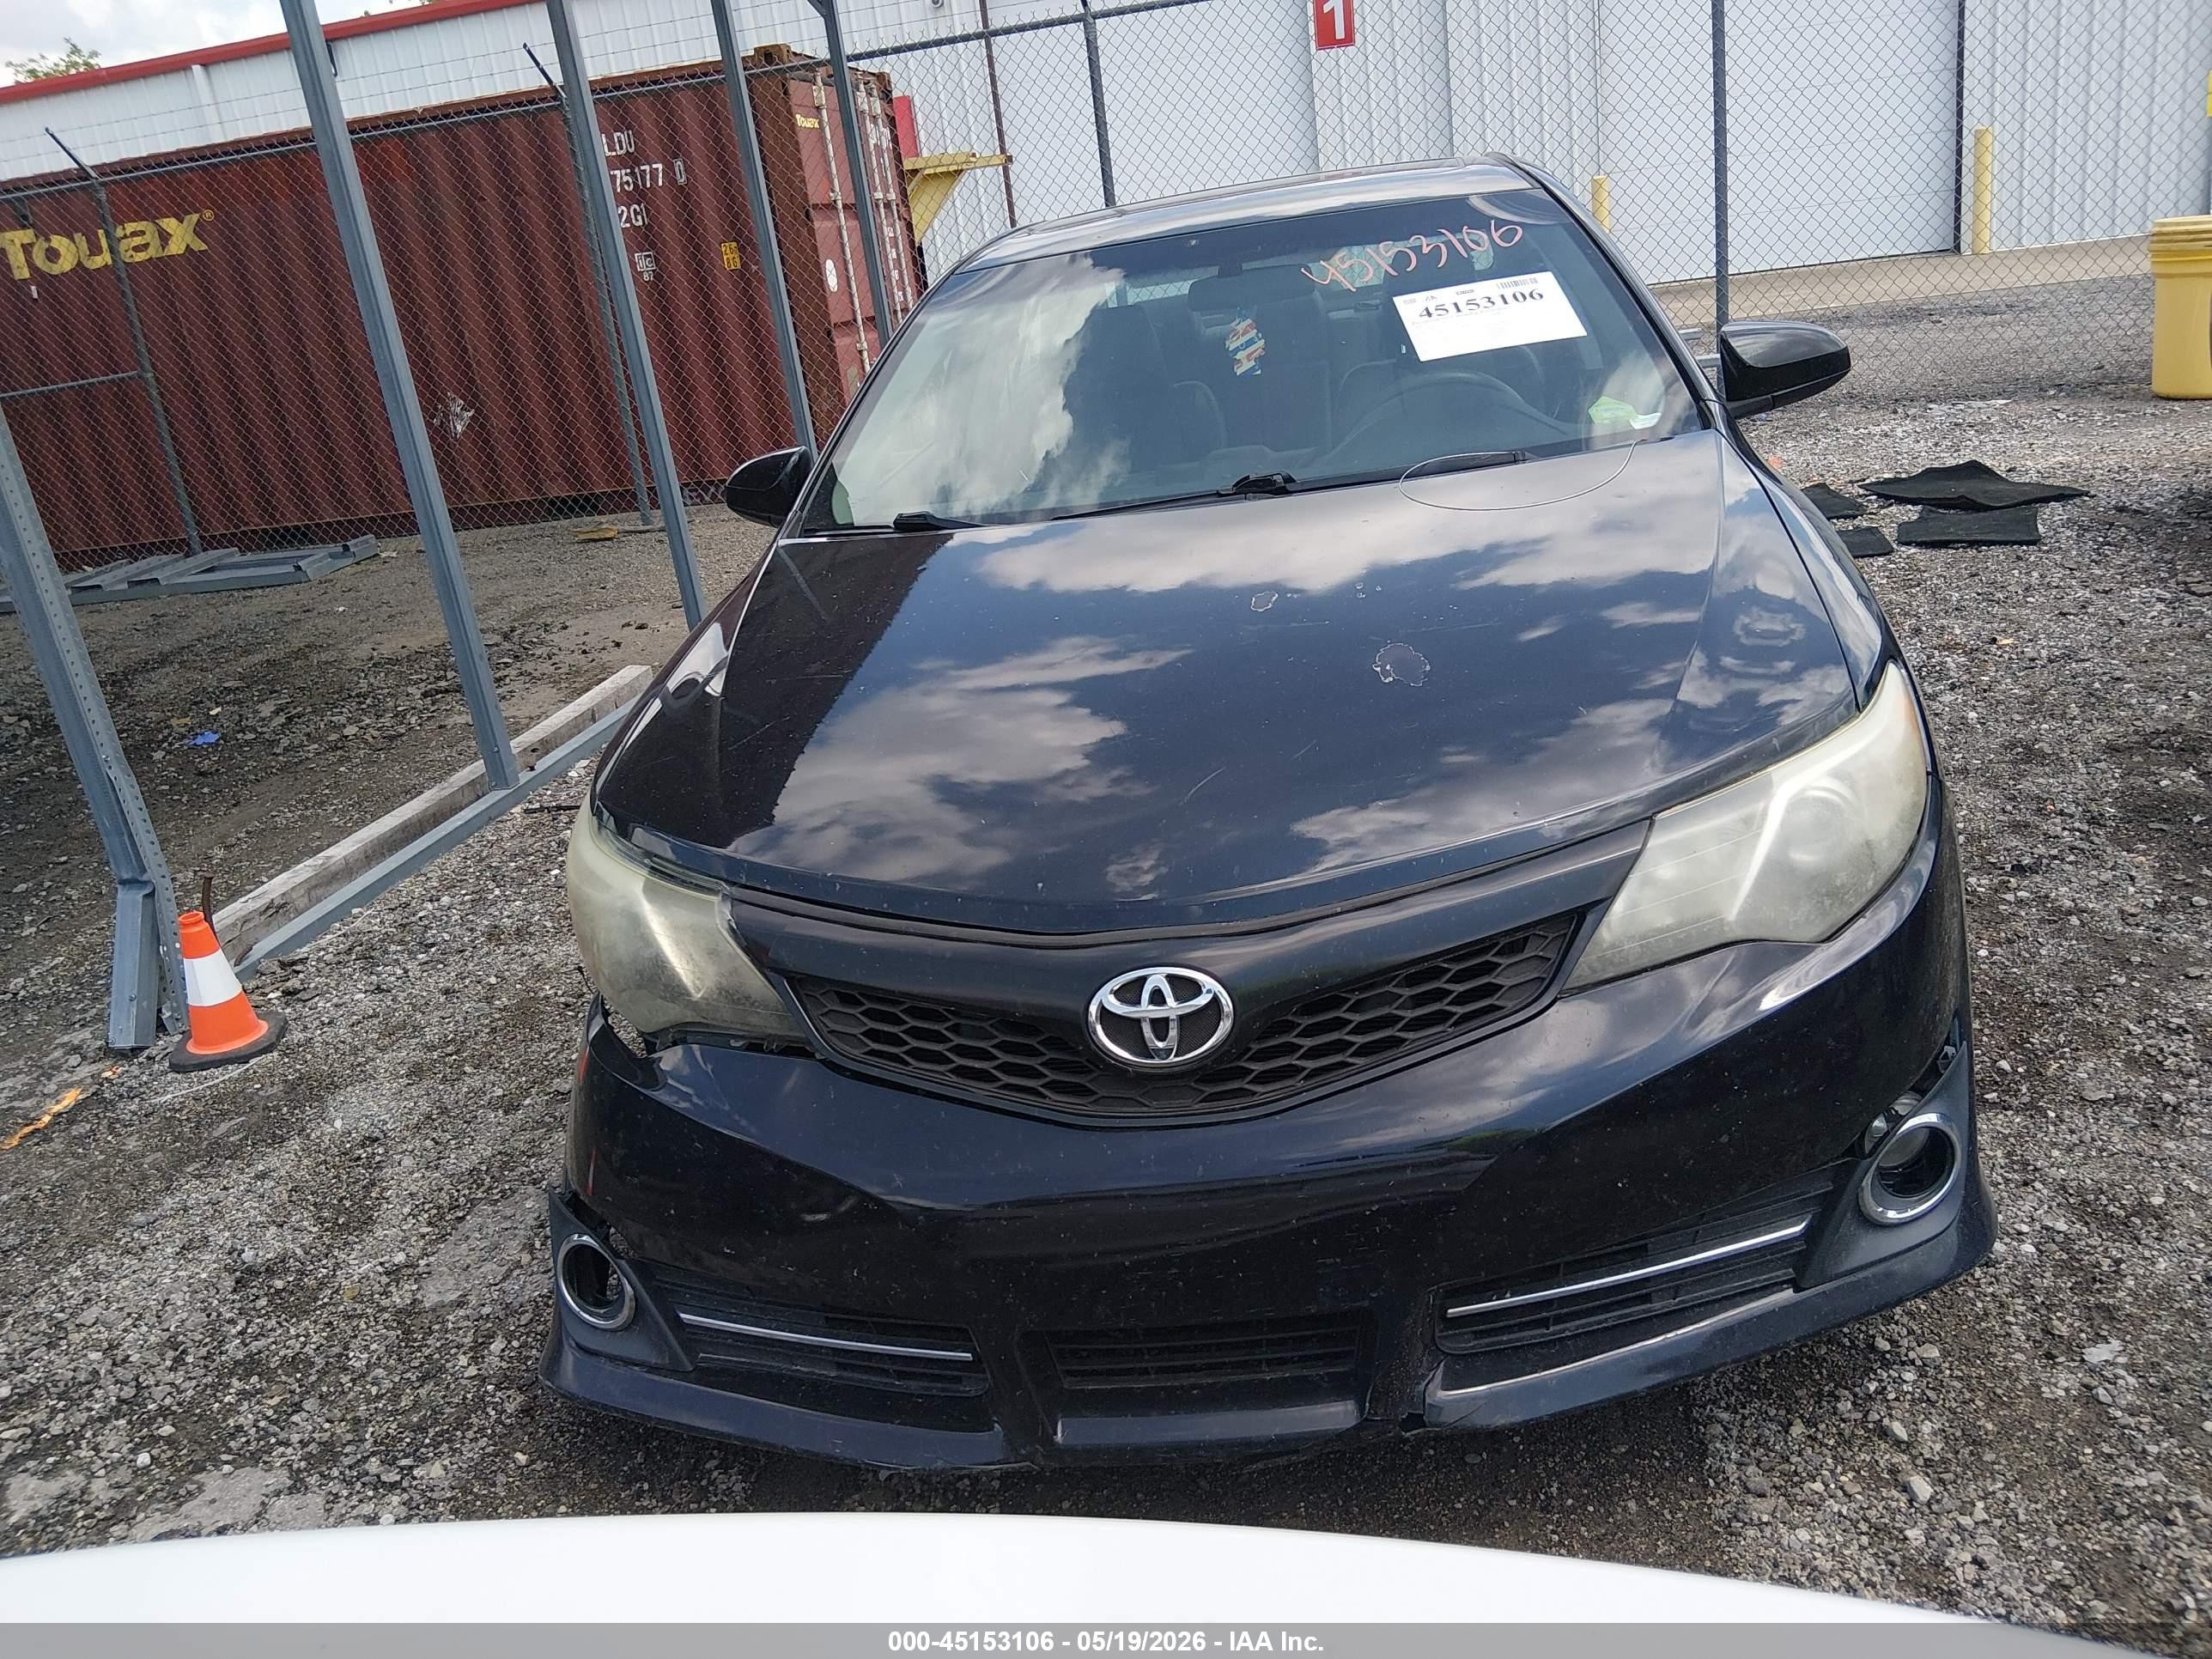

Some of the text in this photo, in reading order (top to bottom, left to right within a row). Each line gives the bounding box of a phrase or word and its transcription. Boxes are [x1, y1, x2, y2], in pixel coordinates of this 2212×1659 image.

[1323, 0, 1345, 40] 1
[601, 130, 635, 156] LDU
[611, 163, 663, 192] 75177
[617, 203, 648, 228] 2G1
[1301, 220, 1523, 292] 45153106
[1419, 288, 1544, 319] 45153106
